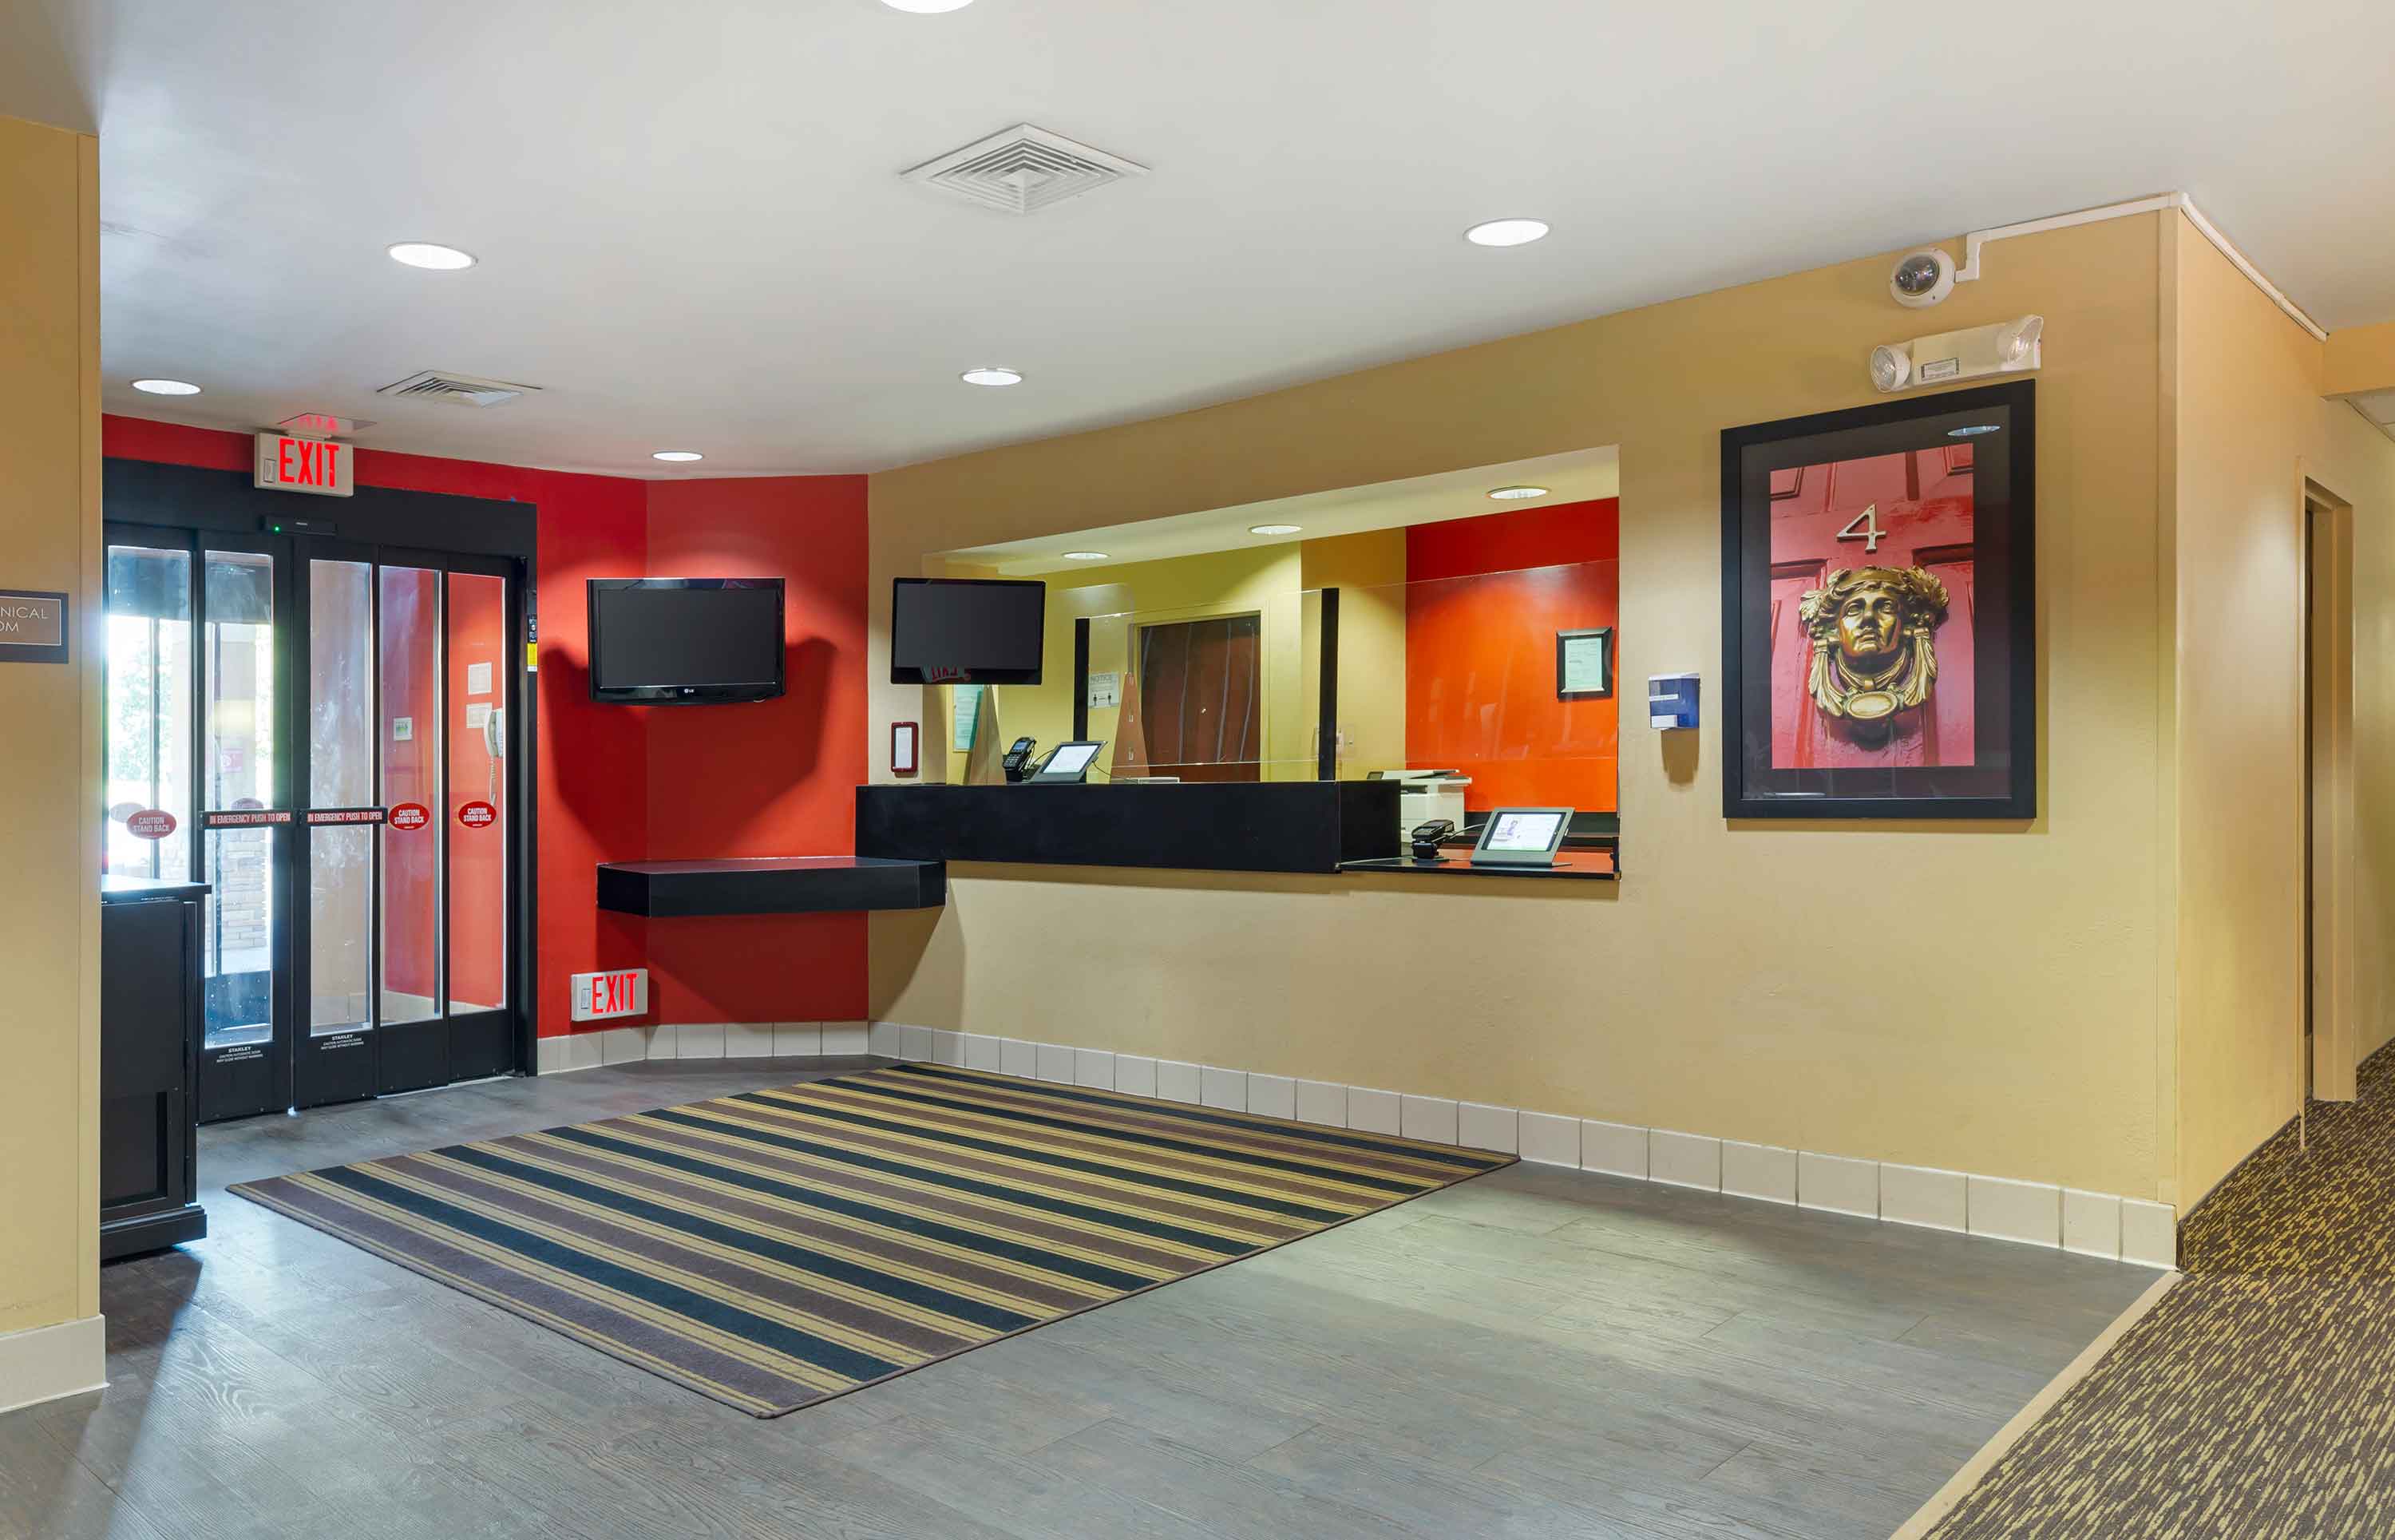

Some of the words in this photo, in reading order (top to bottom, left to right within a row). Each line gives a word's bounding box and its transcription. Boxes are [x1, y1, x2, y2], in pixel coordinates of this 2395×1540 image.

[279, 437, 339, 488] EXIT
[1836, 504, 1886, 554] 4
[0, 607, 49, 620] NICAL
[217, 814, 250, 824] EMERGENCY
[251, 814, 267, 822] PUSH
[267, 814, 275, 822] TO
[275, 812, 291, 822] OPEN
[315, 813, 345, 822] EMERGENCY
[346, 812, 360, 821] PUSH
[361, 812, 368, 821] TO
[369, 811, 382, 821] OPEN
[592, 972, 638, 1014] EXIT
